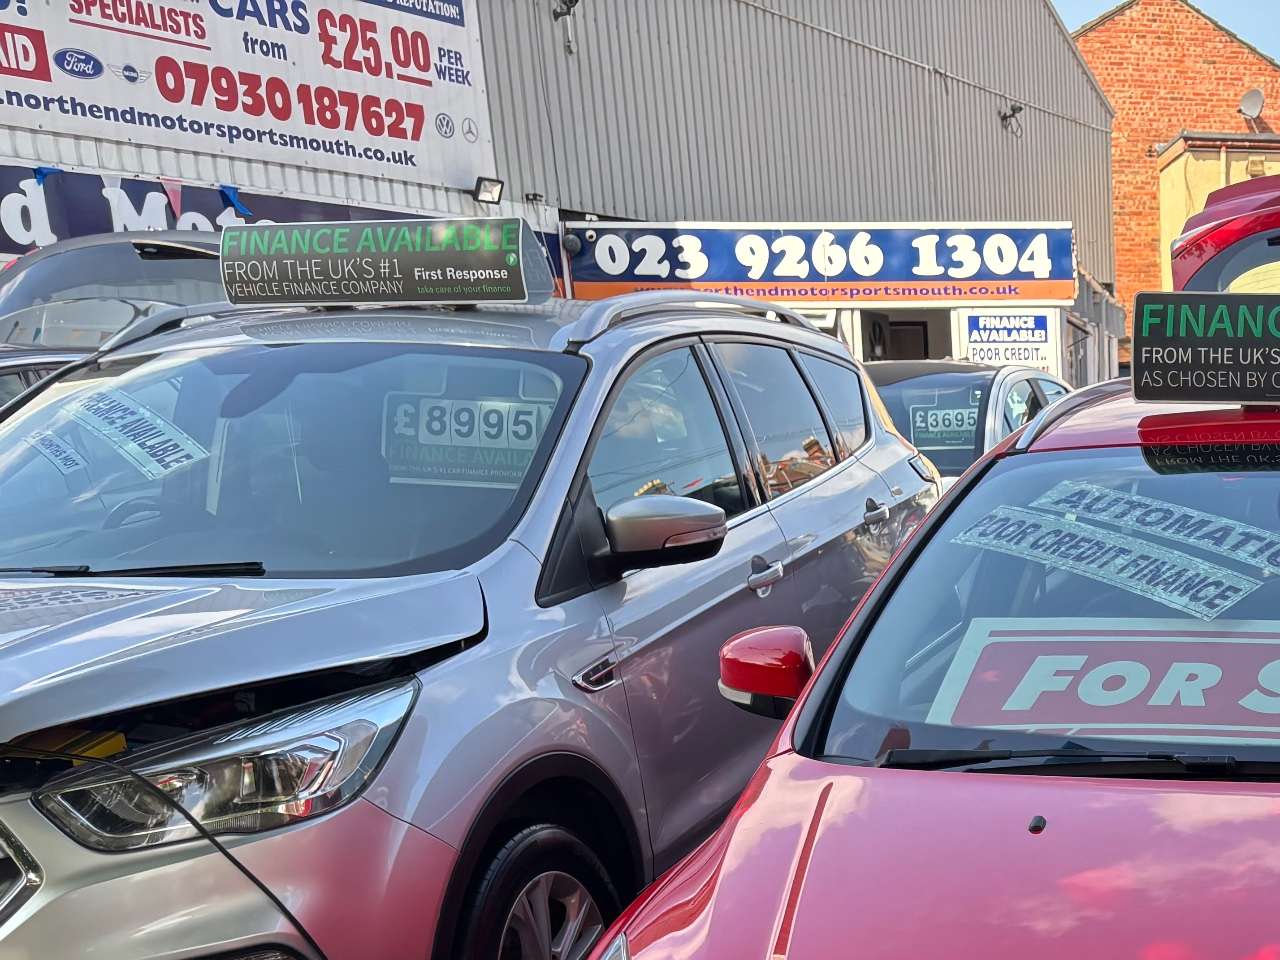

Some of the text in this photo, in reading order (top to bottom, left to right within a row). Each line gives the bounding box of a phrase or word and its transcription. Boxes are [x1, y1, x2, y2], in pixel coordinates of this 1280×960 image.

[69, 0, 207, 40] SPECIALISTS
[243, 9, 431, 79] from £25.00
[437, 47, 464, 68] PER
[434, 63, 472, 87] WEEK
[222, 223, 519, 257] FINANCE AVAILABLE
[595, 232, 1051, 280] 023 9266 1304
[223, 257, 403, 281] FROM THE UK'S #1
[414, 267, 508, 283] First Response
[227, 280, 404, 297] VEHICLE FINANCE COMPANY
[979, 317, 1035, 329] FINANCE
[970, 330, 1046, 342] AVAILABLE!
[972, 348, 1000, 360] POOR
[1142, 347, 1192, 365] FROM
[1197, 347, 1233, 365] THE
[1239, 348, 1280, 366] UK'S
[1142, 370, 1163, 387] AS
[1167, 370, 1241, 388] CHOSEN
[1246, 371, 1268, 388] BY
[393, 403, 534, 441] £8995
[915, 410, 977, 428] £3695
[116, 418, 194, 470] AVAILABLE
[968, 515, 1244, 611] POOR CREDIT FINANCE
[1002, 655, 1223, 711] FOR
